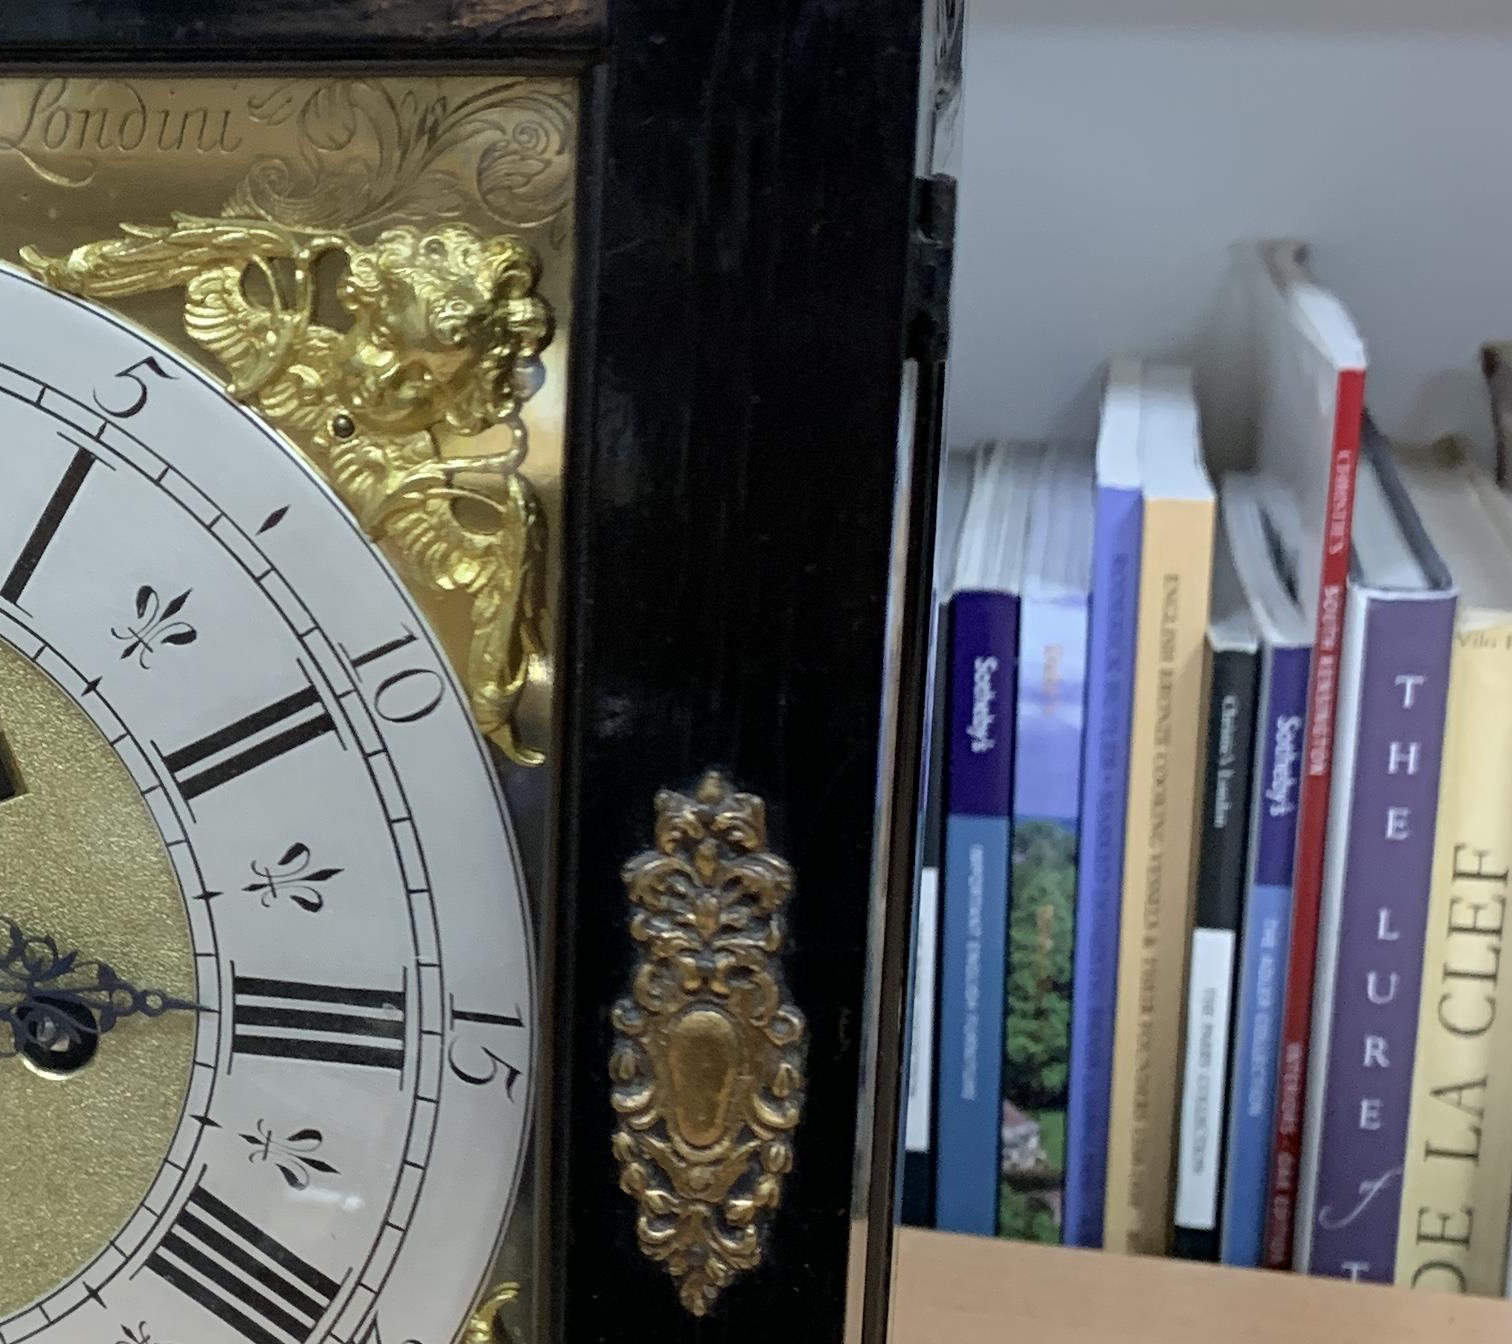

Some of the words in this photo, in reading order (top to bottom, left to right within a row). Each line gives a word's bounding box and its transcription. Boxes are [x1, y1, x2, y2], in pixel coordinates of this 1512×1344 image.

[91, 355, 182, 419] 5
[338, 622, 445, 723] 10
[970, 656, 999, 755] Sotheby's
[149, 657, 348, 823] II
[1268, 715, 1301, 818] Sotheby's
[227, 960, 408, 1091] III
[448, 993, 525, 1101] 15
[1359, 908, 1401, 1131] LURE
[1425, 1077, 1488, 1164] LA
